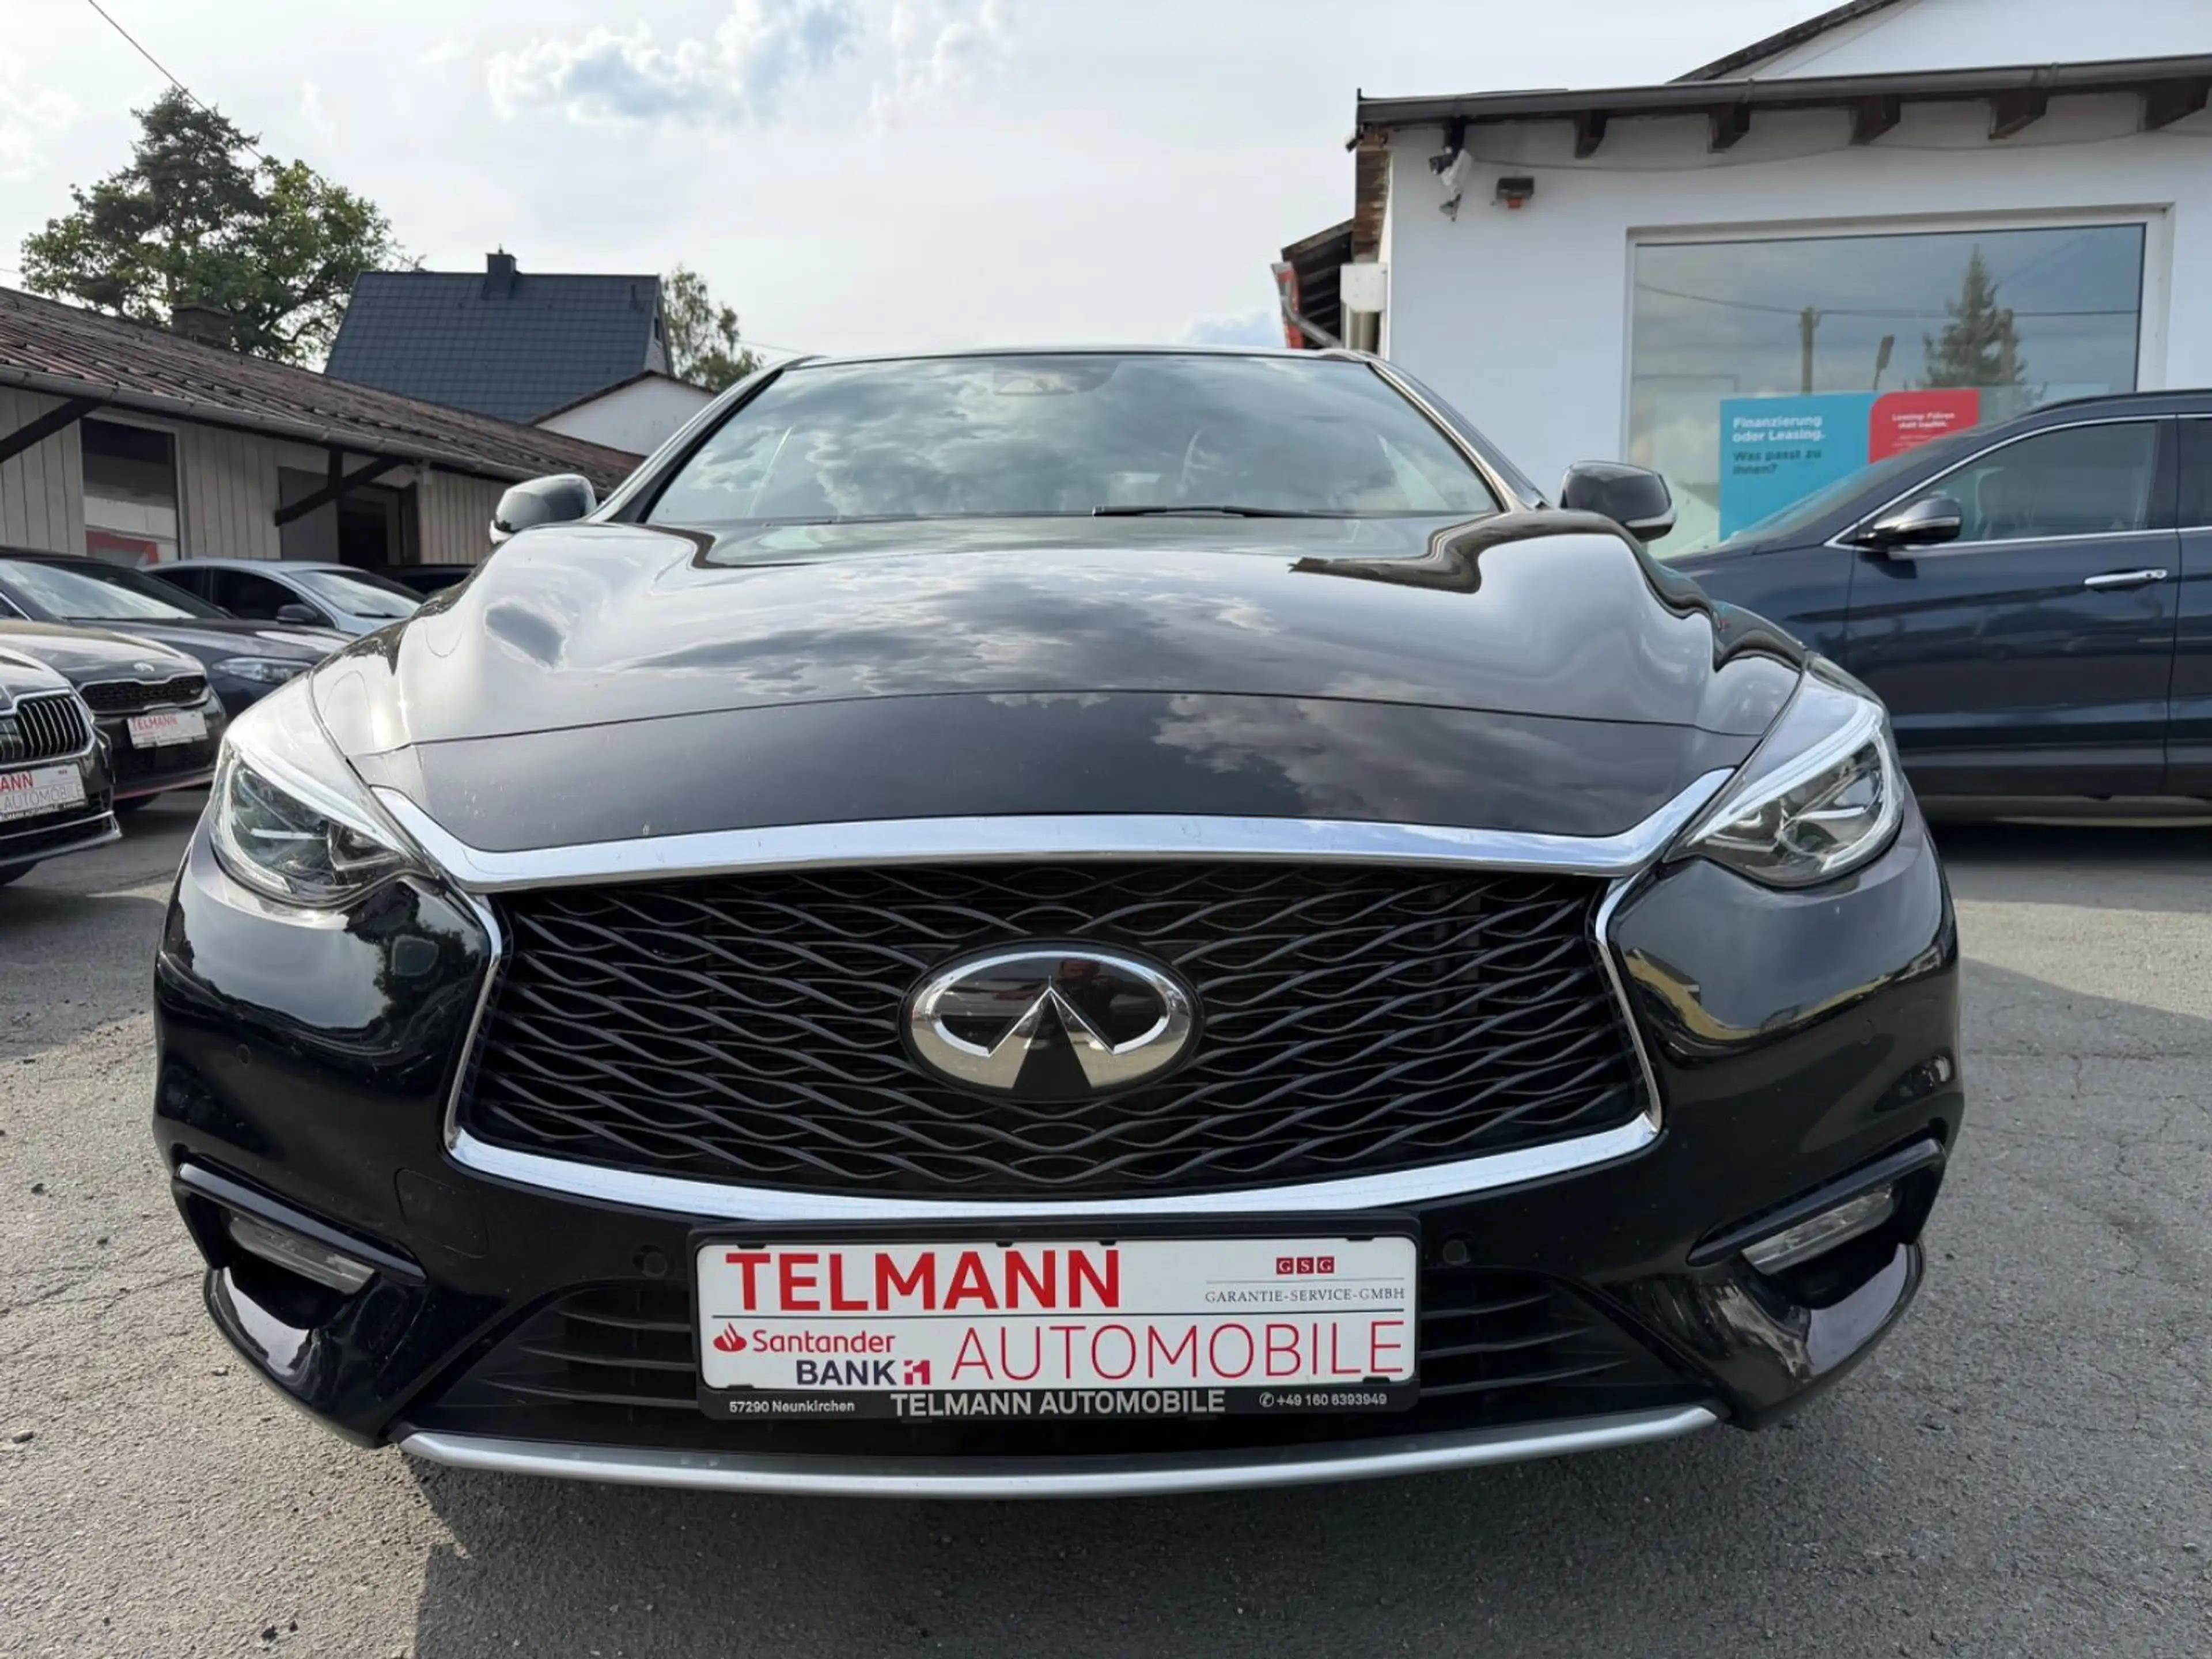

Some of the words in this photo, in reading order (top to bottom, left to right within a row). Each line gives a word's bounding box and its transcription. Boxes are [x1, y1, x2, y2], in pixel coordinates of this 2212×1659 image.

[1733, 416, 1823, 429] Finanzierung
[1732, 431, 1766, 442] oder
[1733, 451, 1762, 461] Was
[726, 1249, 1119, 1311] TELMANN
[1205, 1288, 1406, 1304] GARANTIE-SERVICE-GMBH
[753, 1330, 896, 1353] Santander
[952, 1321, 1404, 1381] AUTOMOBILE
[772, 1400, 855, 1412] Neunkirchen
[891, 1392, 1031, 1417] TELMANN
[1040, 1389, 1226, 1415] AUTOMOBILE
